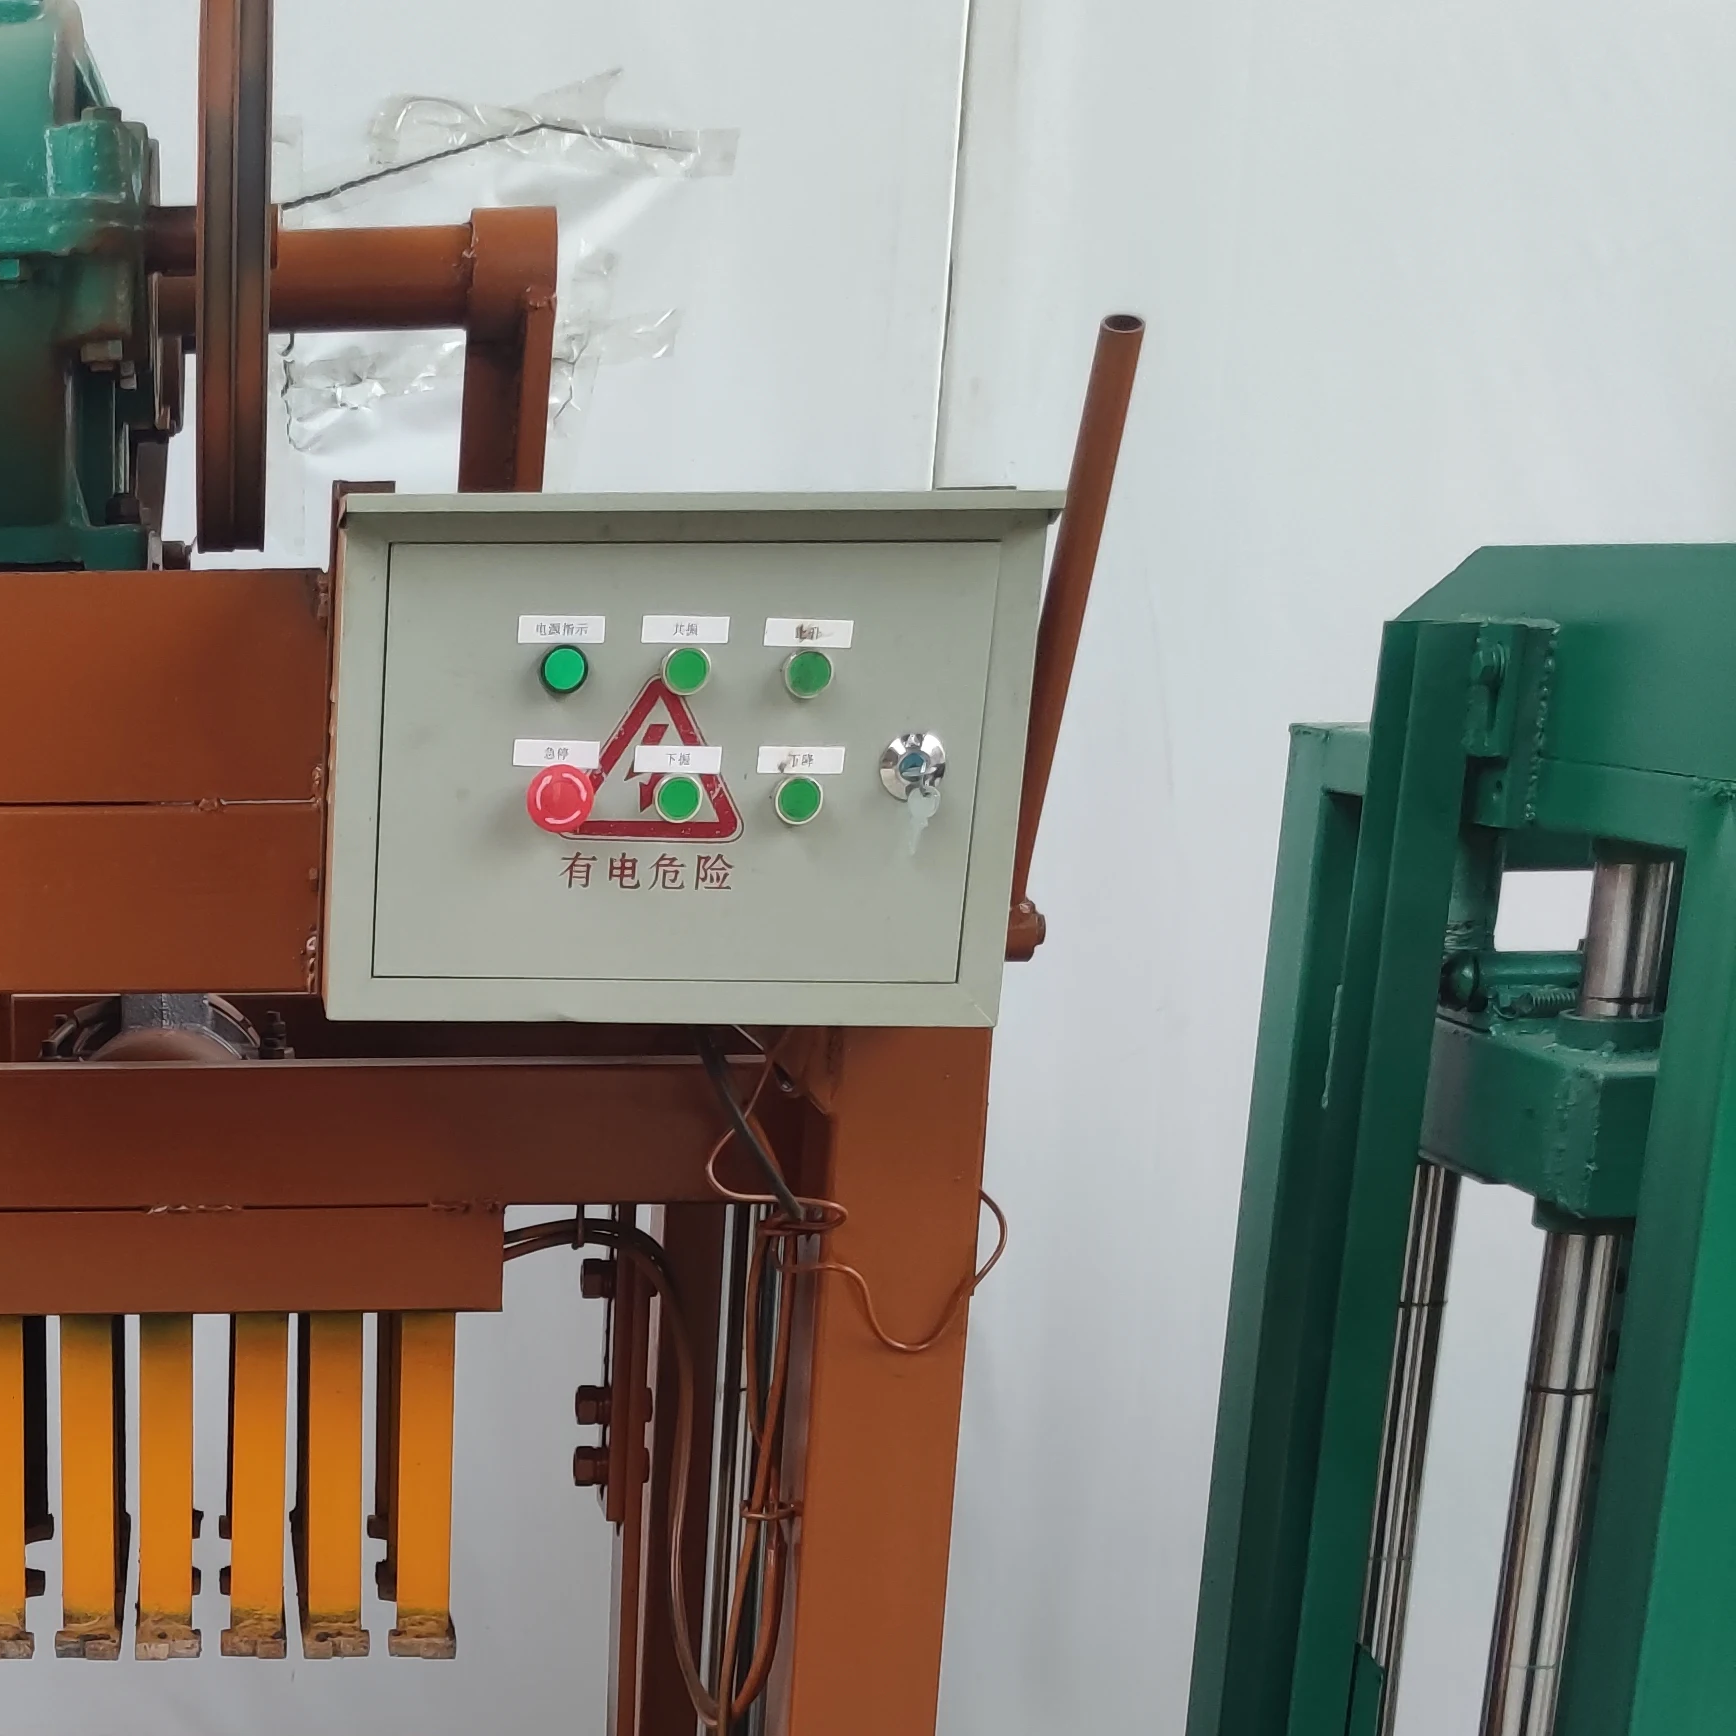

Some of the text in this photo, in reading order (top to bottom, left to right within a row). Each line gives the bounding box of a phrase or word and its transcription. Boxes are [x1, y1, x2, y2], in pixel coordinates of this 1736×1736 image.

[544, 746, 569, 761] 急停
[558, 851, 735, 891] 有电危险
